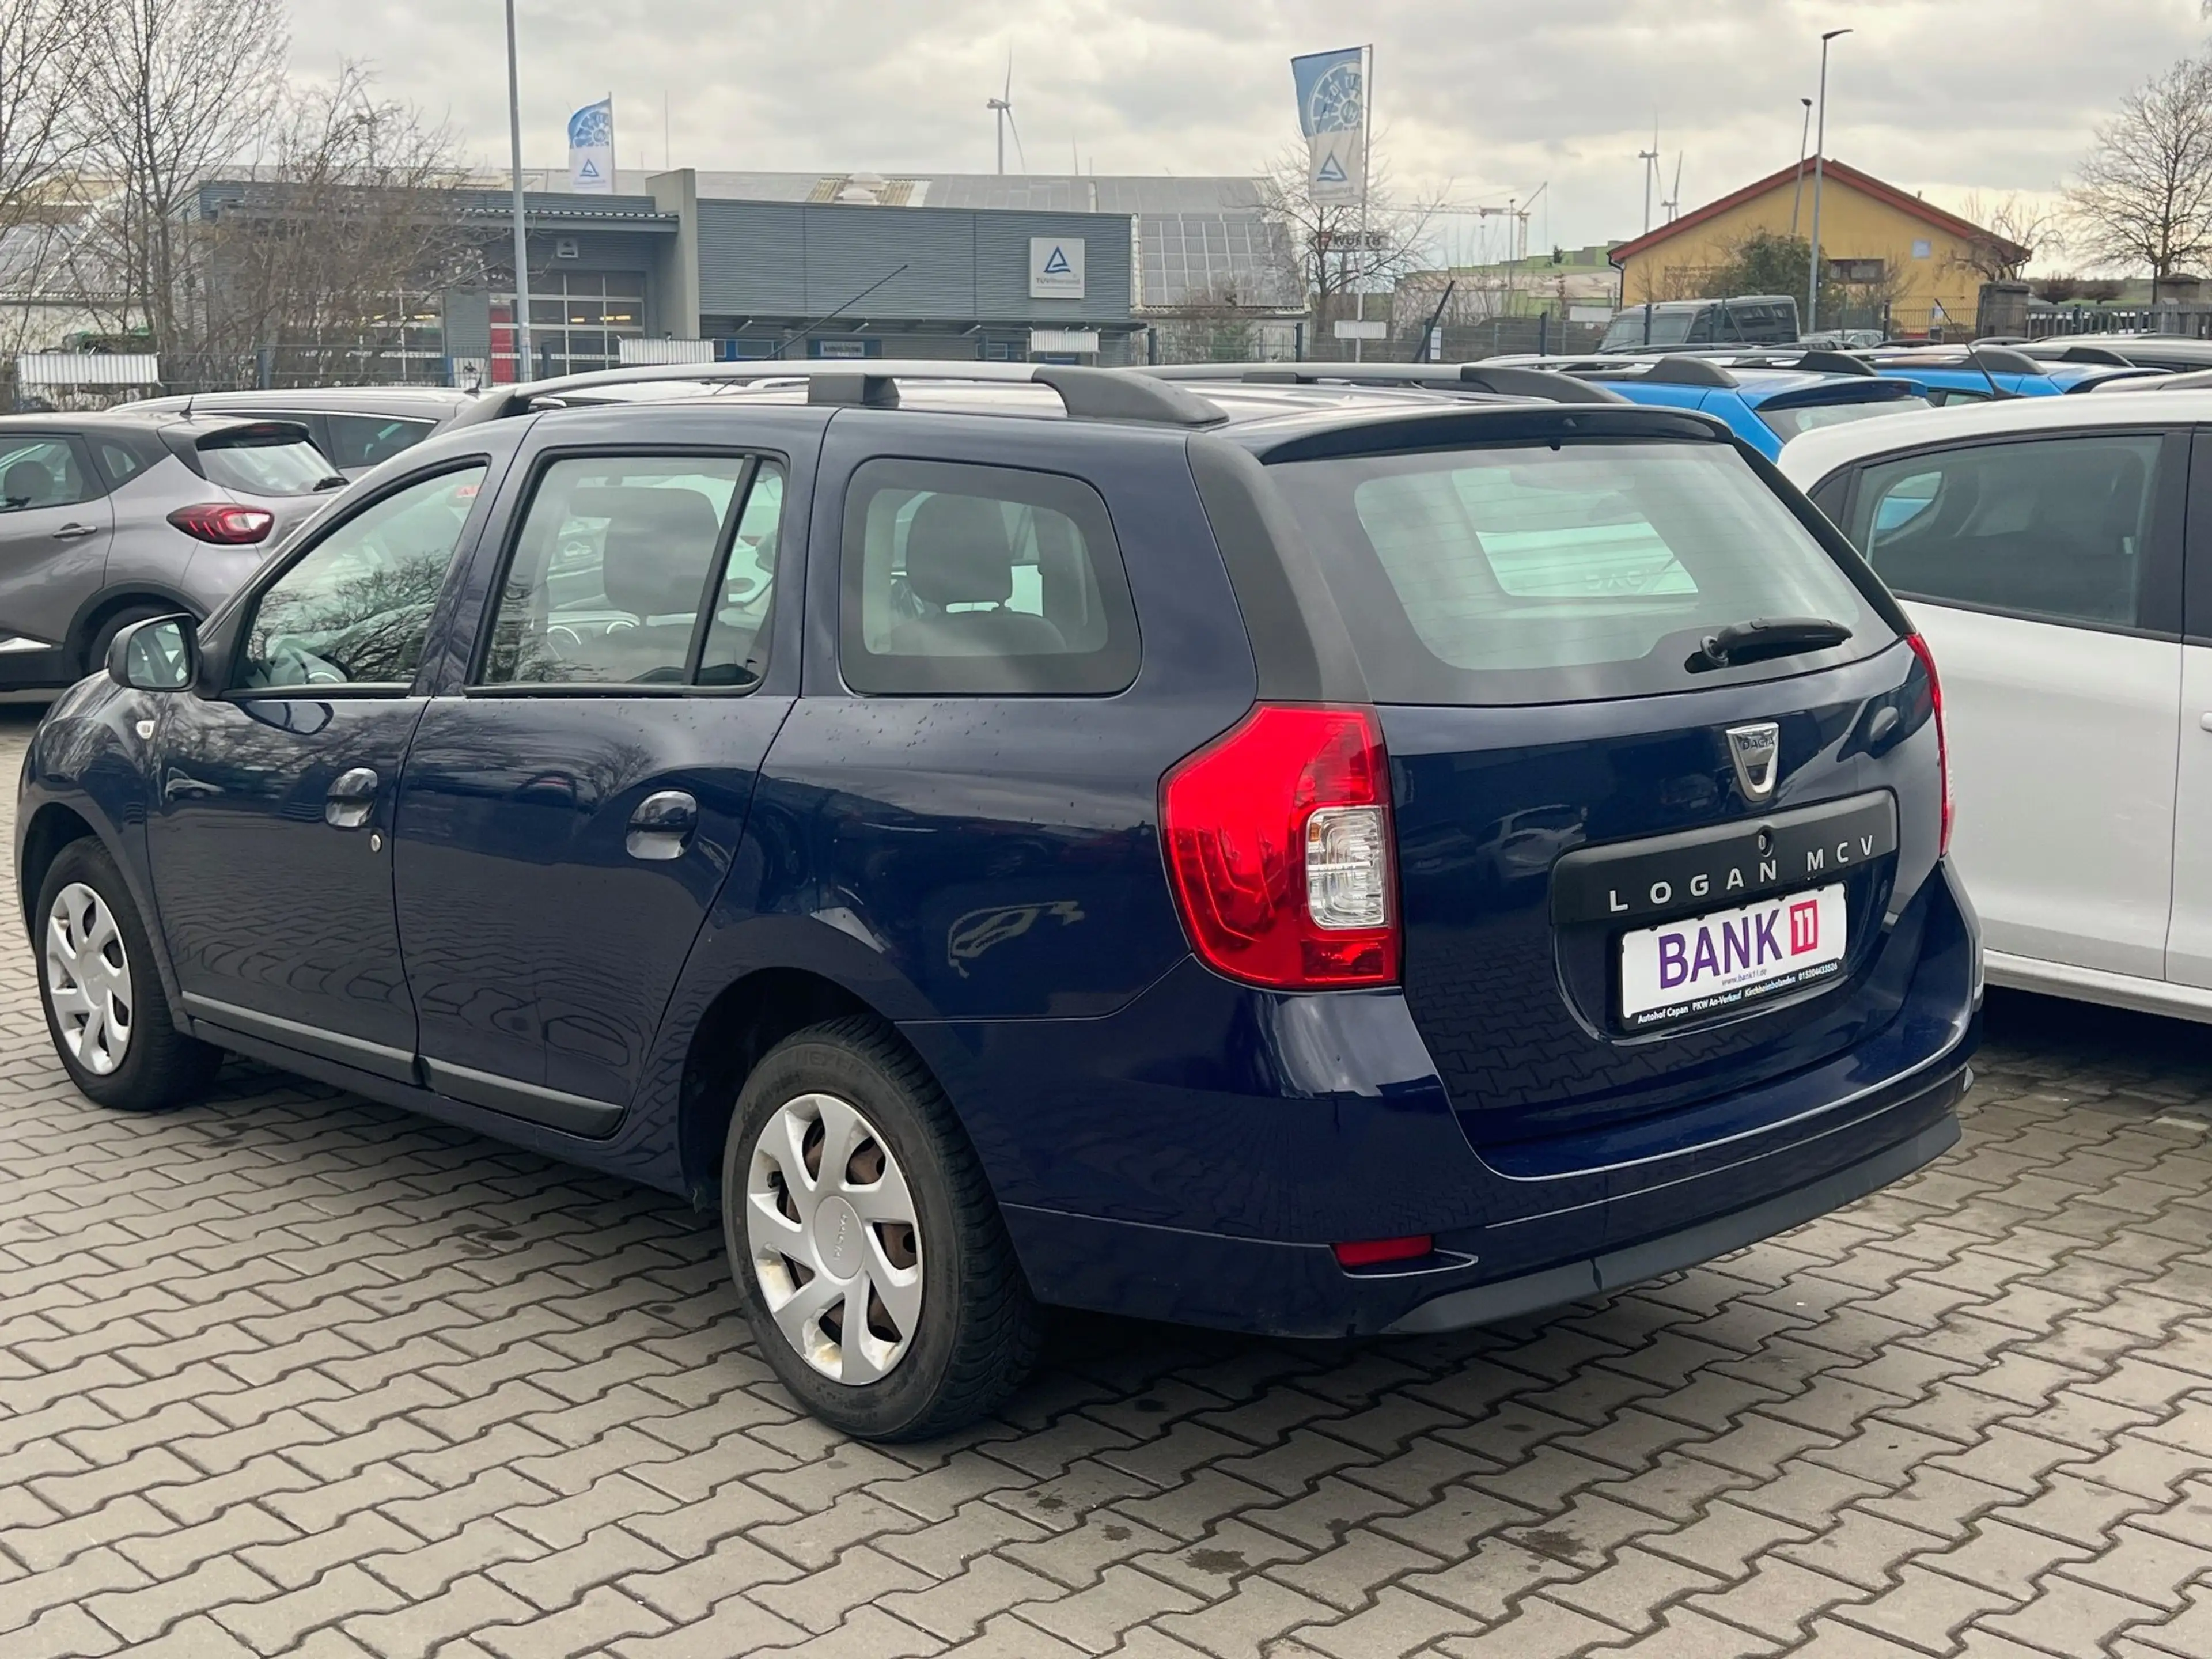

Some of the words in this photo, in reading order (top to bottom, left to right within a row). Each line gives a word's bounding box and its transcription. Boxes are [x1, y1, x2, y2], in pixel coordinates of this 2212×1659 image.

[1743, 737, 1775, 750] DACIA
[1609, 859, 1777, 912] LOGAN
[1806, 835, 1873, 872] MCV
[1658, 908, 1783, 990] BANK
[1638, 1009, 1666, 1024] Autohof
[1666, 1006, 1688, 1018] Capan
[1692, 999, 1709, 1012] PKW
[1709, 990, 1742, 1007] An-Verkauf
